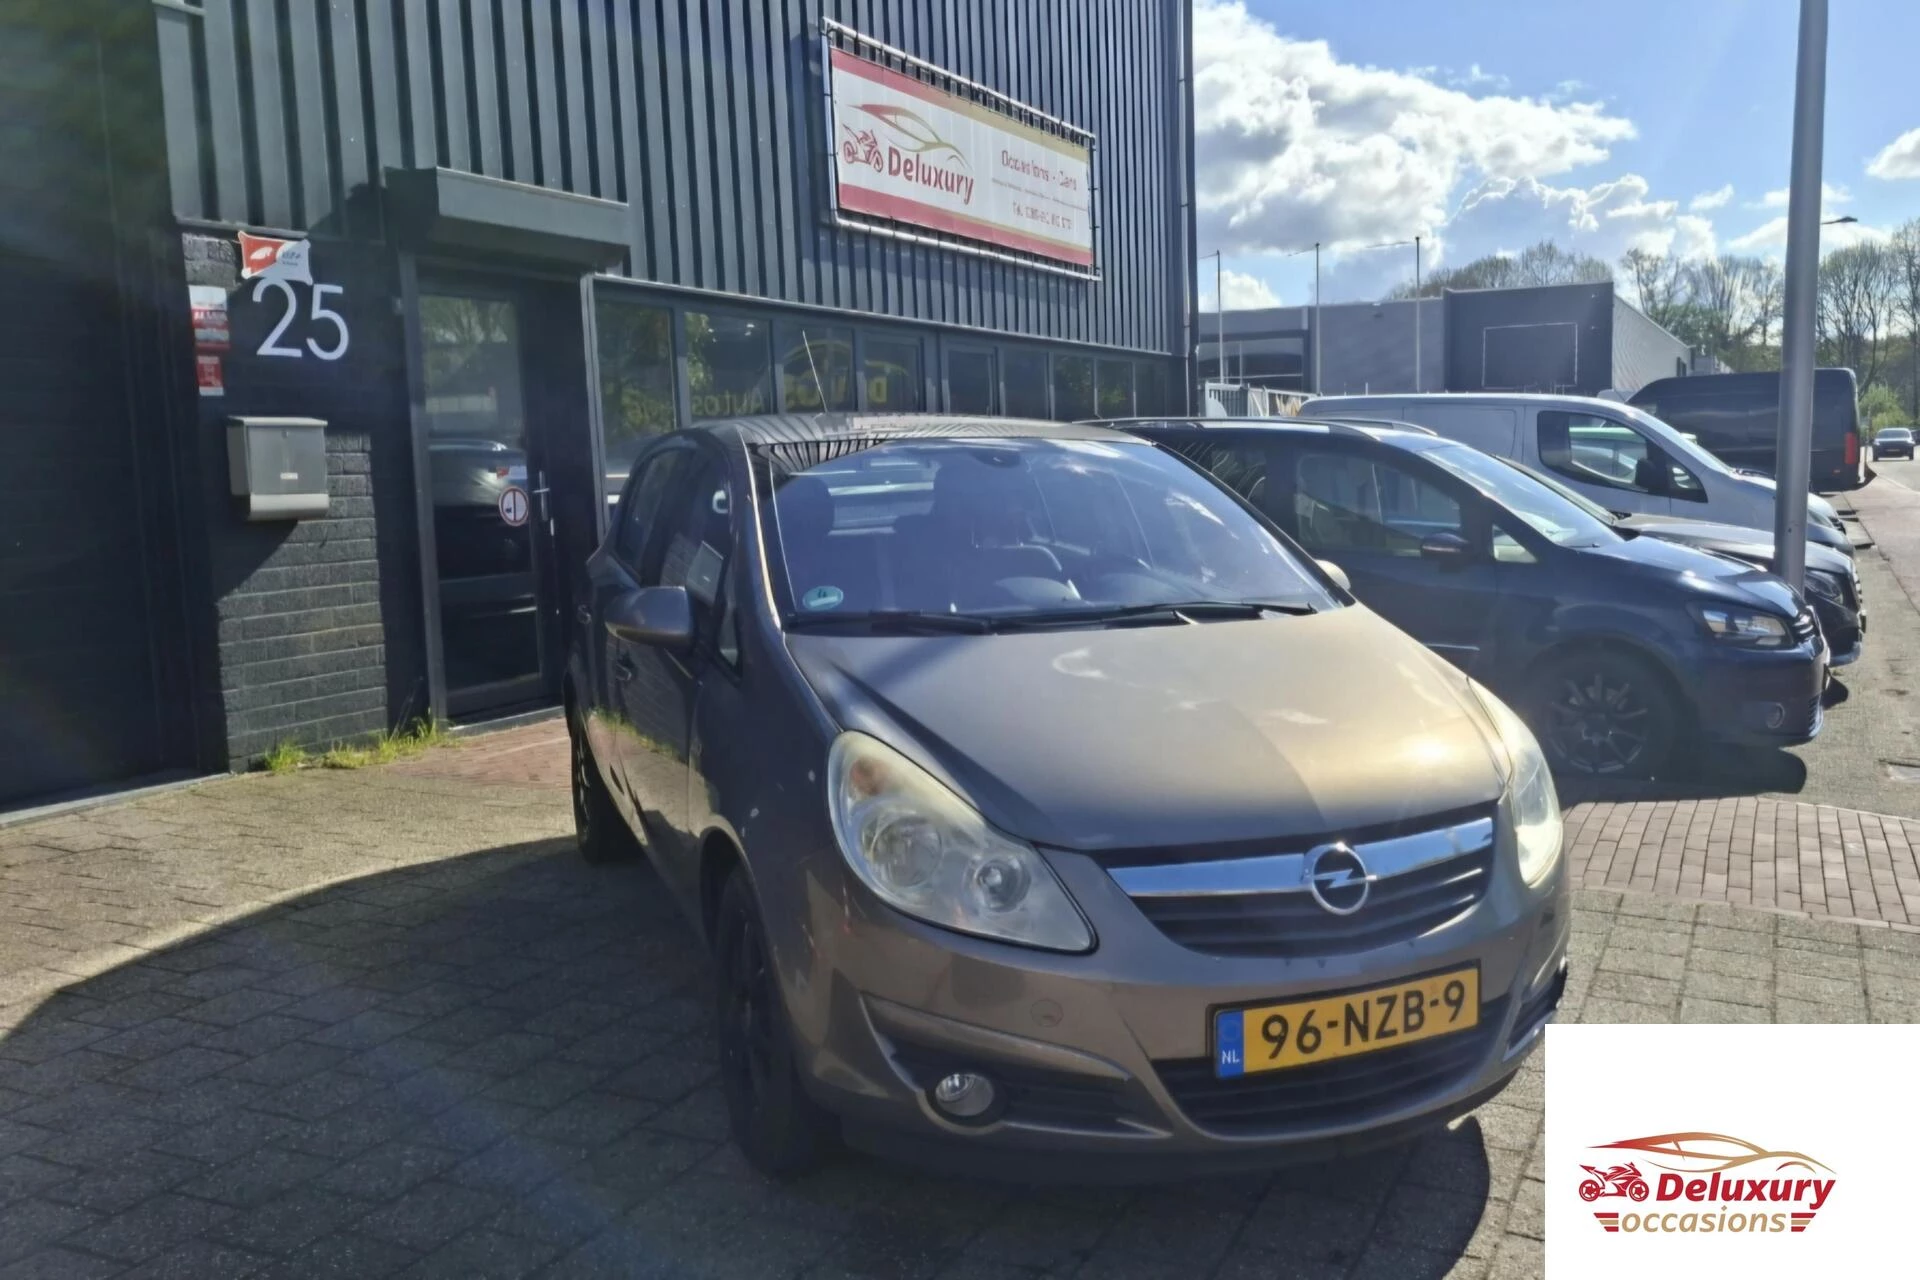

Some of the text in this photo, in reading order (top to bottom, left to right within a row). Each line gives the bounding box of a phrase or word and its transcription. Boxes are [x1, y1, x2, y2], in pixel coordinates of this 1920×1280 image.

[888, 146, 974, 206] Deluxury
[252, 277, 349, 361] 25
[1261, 979, 1466, 1060] 96-NZB-9
[1221, 1050, 1240, 1065] NL
